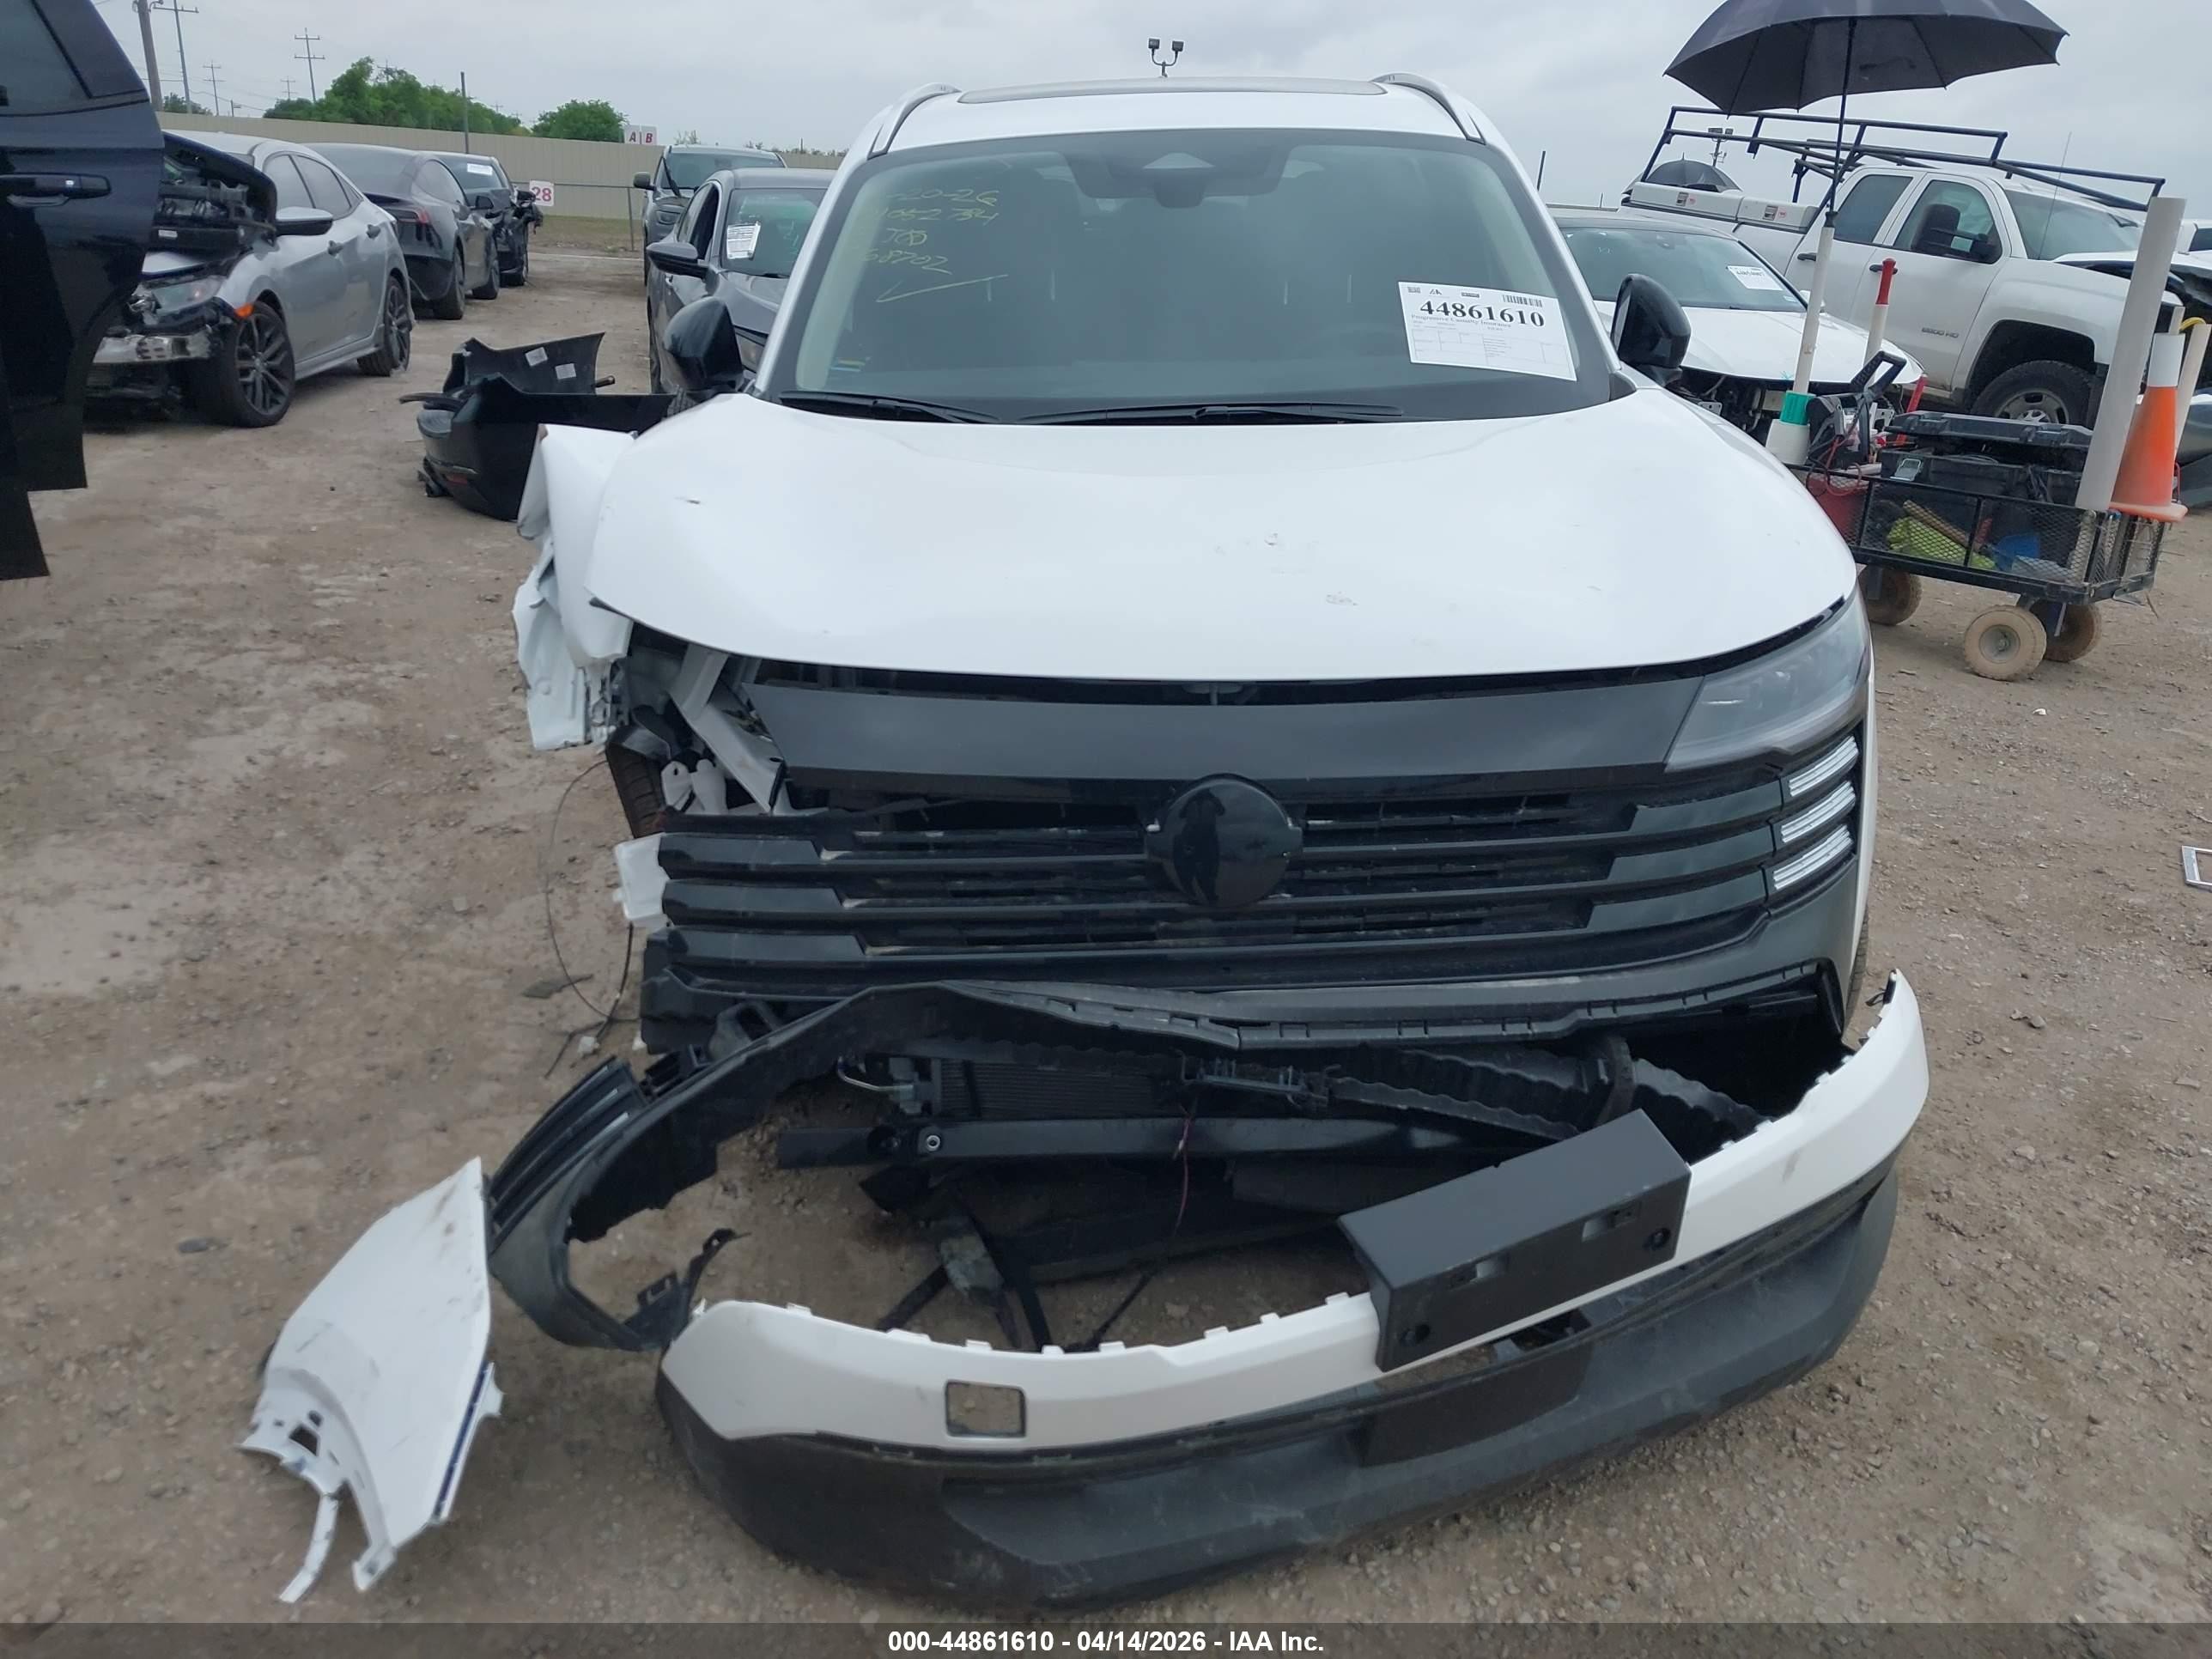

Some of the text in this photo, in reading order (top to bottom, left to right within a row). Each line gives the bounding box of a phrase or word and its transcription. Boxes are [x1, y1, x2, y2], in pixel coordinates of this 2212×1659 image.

[629, 131, 653, 143] A B
[532, 186, 552, 202] 28
[1419, 300, 1545, 327] 44861610
